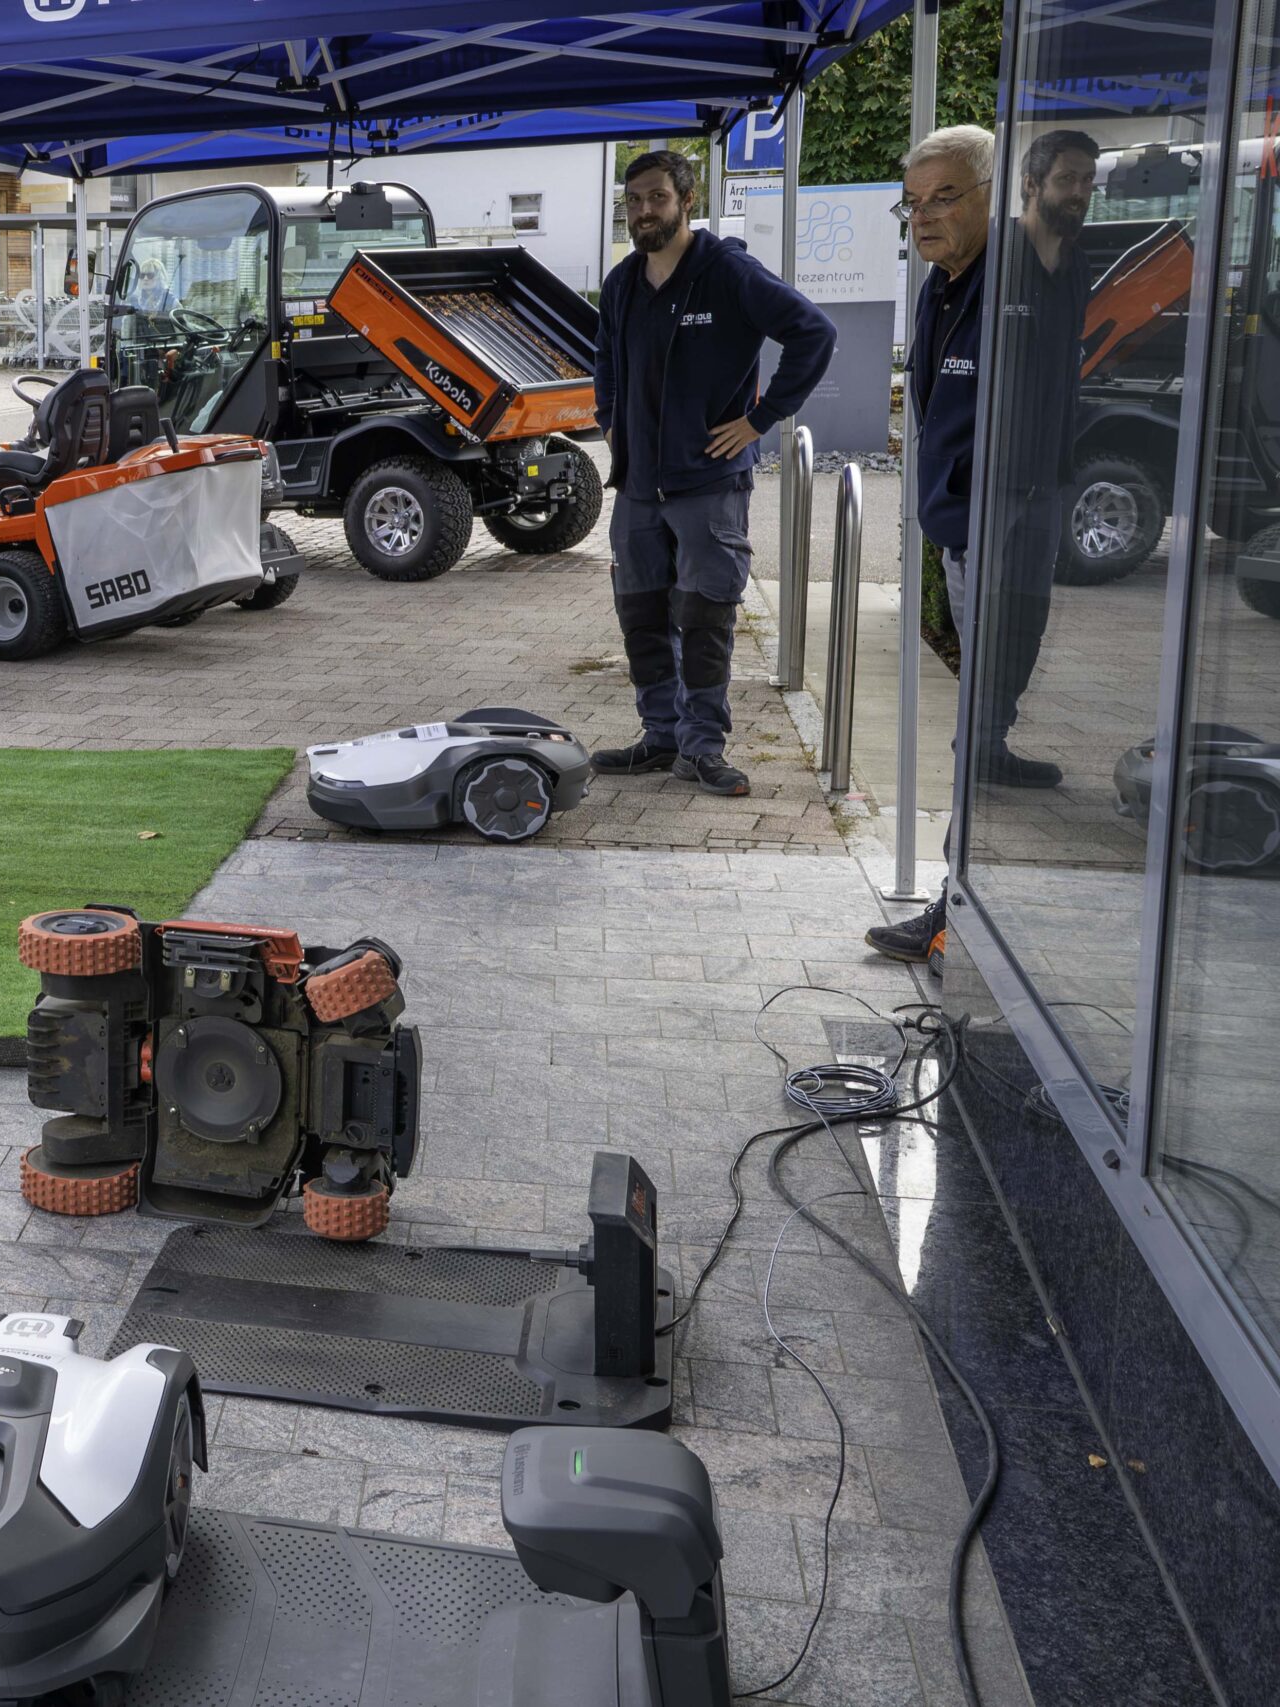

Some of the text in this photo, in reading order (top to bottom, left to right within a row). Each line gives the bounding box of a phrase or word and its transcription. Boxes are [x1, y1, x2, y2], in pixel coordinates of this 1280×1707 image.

[732, 199, 743, 211] 70
[796, 271, 865, 283] tezentrum
[425, 360, 472, 412] Kubota
[84, 568, 152, 610] SABO
